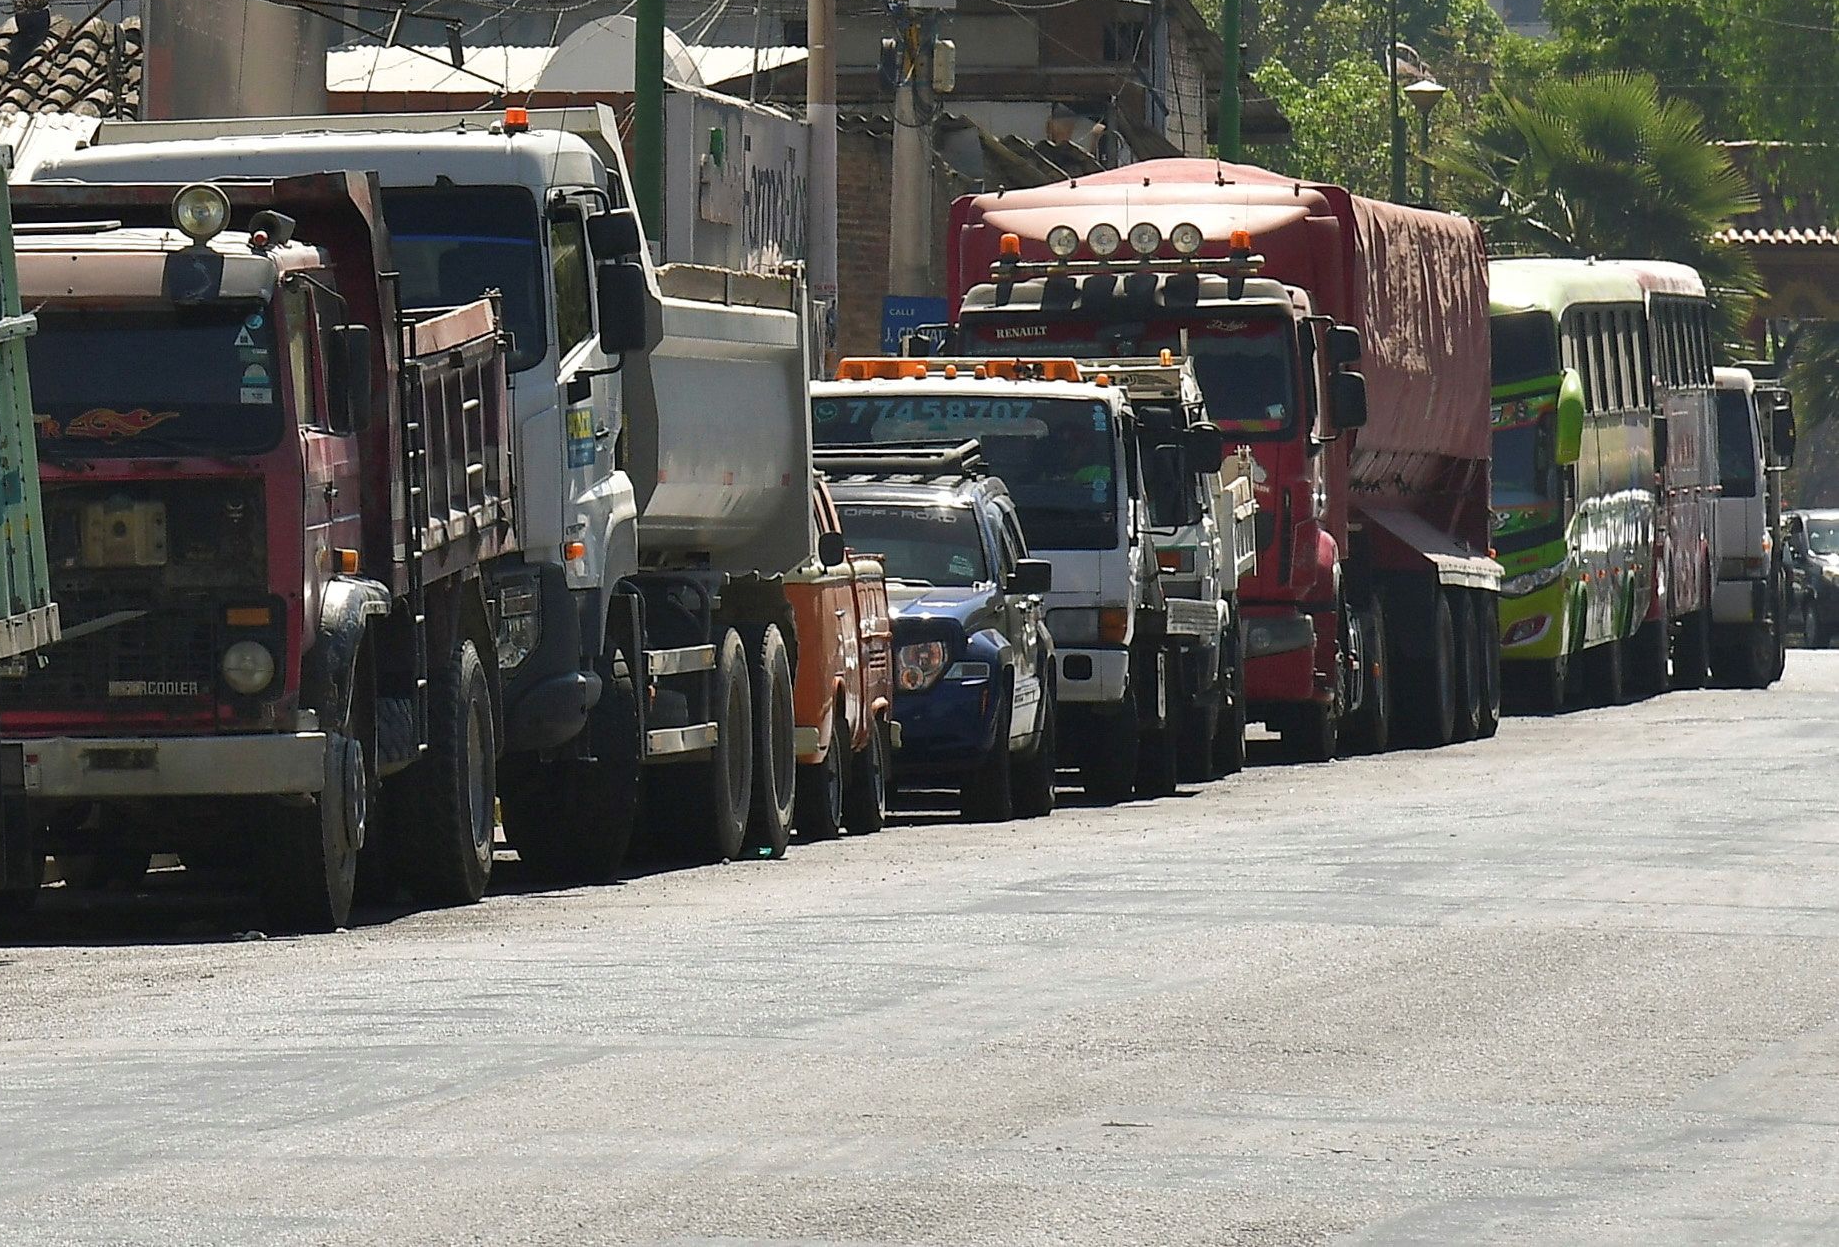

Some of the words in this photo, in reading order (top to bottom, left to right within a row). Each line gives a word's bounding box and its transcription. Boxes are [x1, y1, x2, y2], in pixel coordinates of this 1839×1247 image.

[889, 308, 915, 316] CALLE
[996, 326, 1048, 339] RENAULT
[847, 401, 1033, 423] 77458707
[901, 510, 958, 523] ROAD
